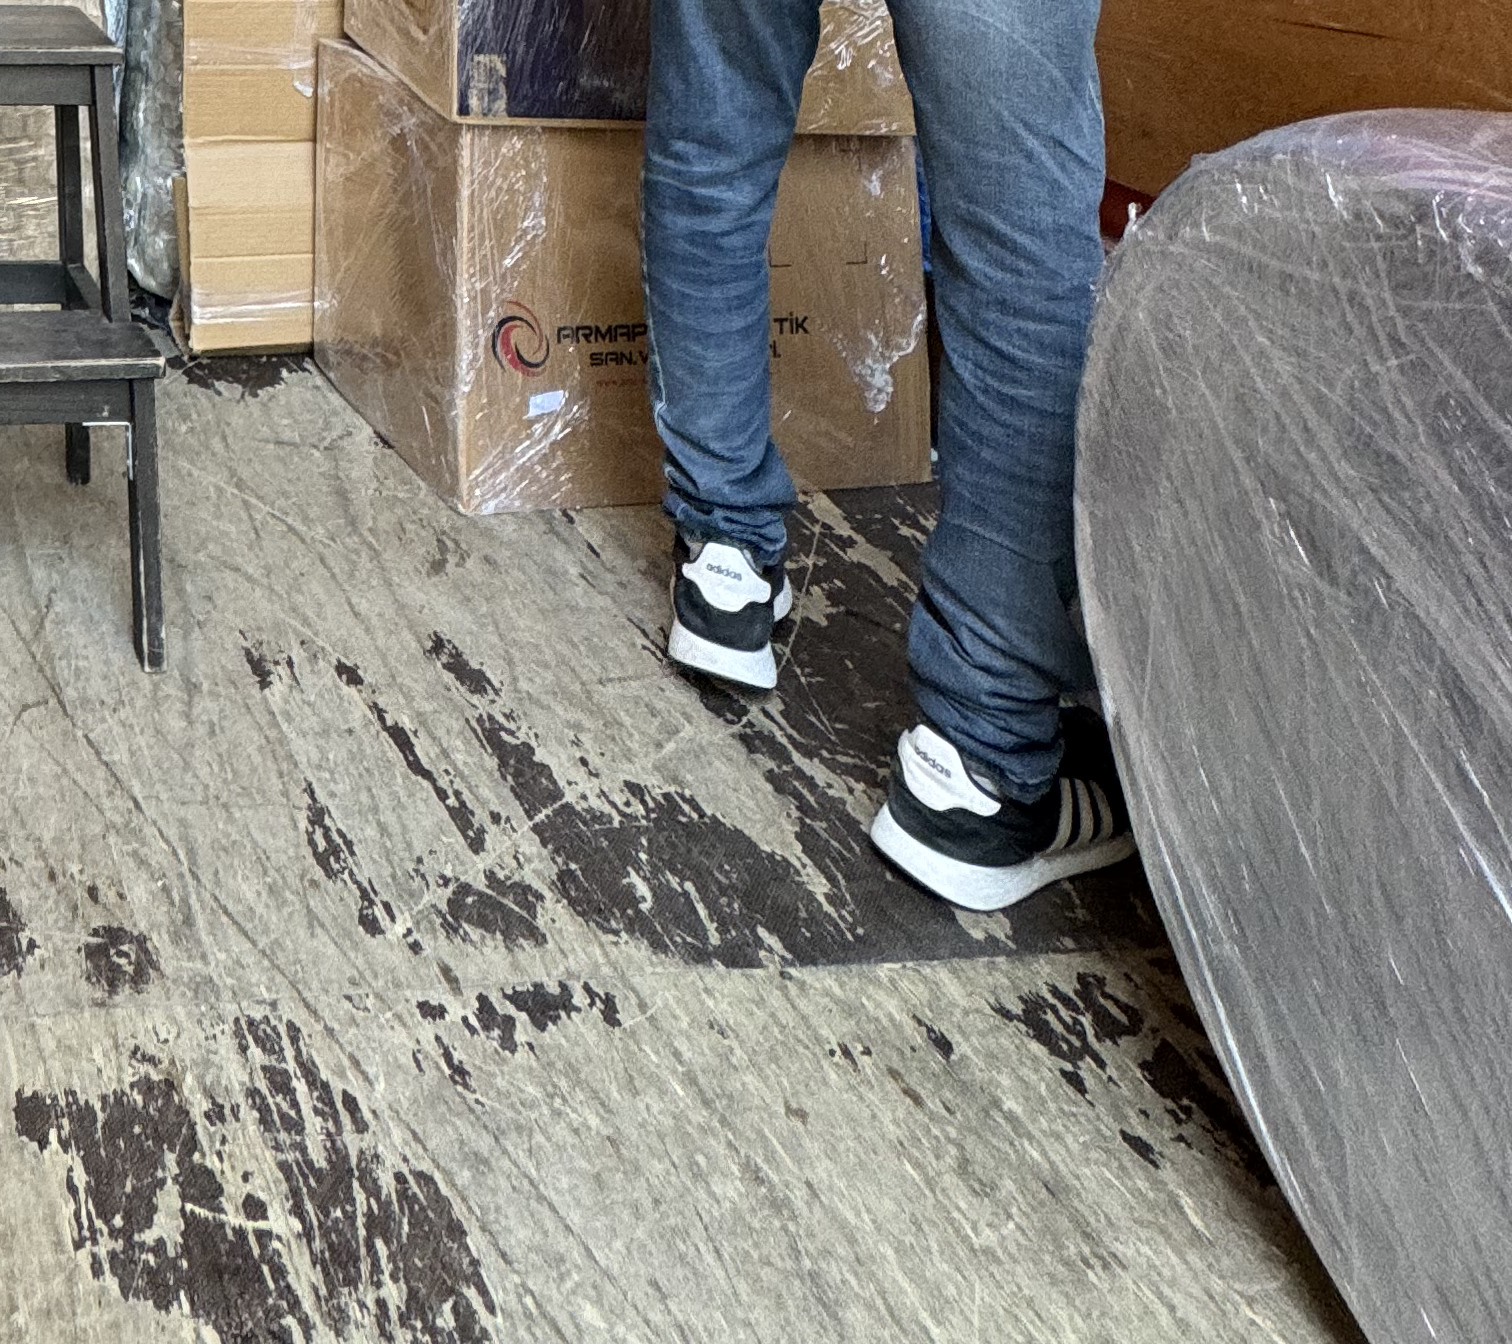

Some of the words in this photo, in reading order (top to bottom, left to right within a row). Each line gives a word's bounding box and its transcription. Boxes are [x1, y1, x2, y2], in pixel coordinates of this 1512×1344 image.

[556, 322, 649, 344] ARMAP
[772, 312, 809, 335] TİK
[589, 348, 649, 367] SAN.V
[706, 563, 742, 581] adidas
